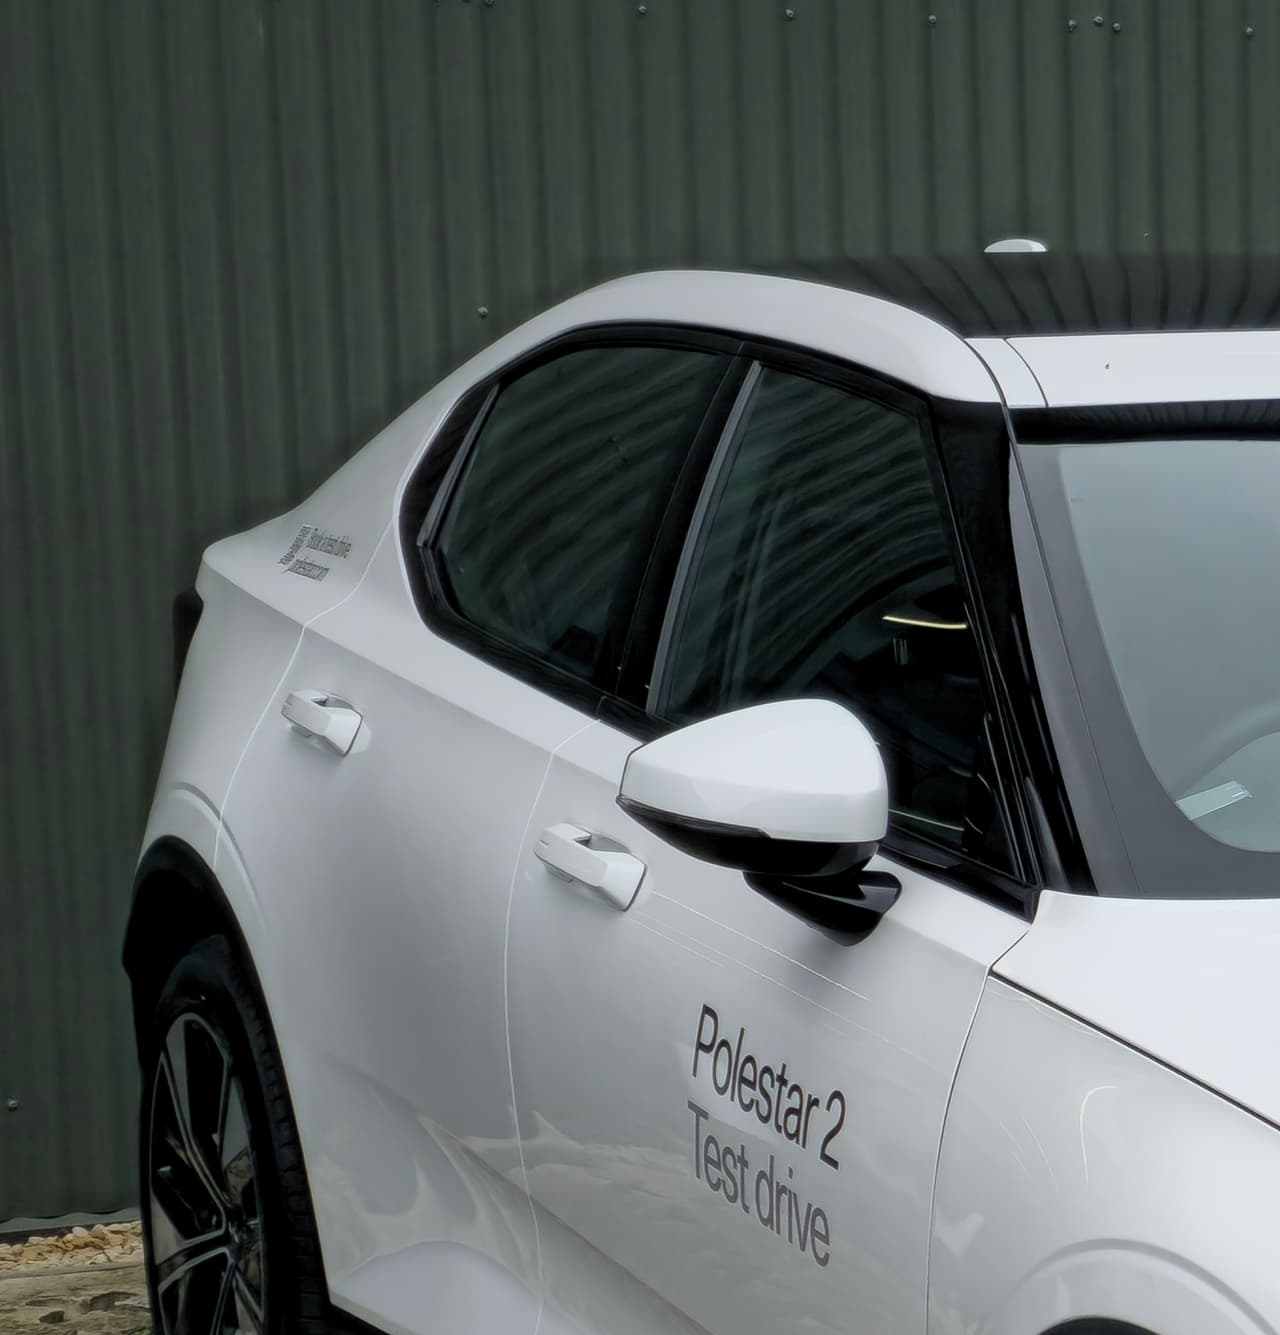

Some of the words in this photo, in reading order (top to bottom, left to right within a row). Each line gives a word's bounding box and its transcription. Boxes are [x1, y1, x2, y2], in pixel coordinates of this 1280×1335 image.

[691, 1003, 819, 1150] Polestar
[819, 1089, 847, 1171] 2
[687, 1099, 750, 1215] Test
[754, 1154, 832, 1268] drive
